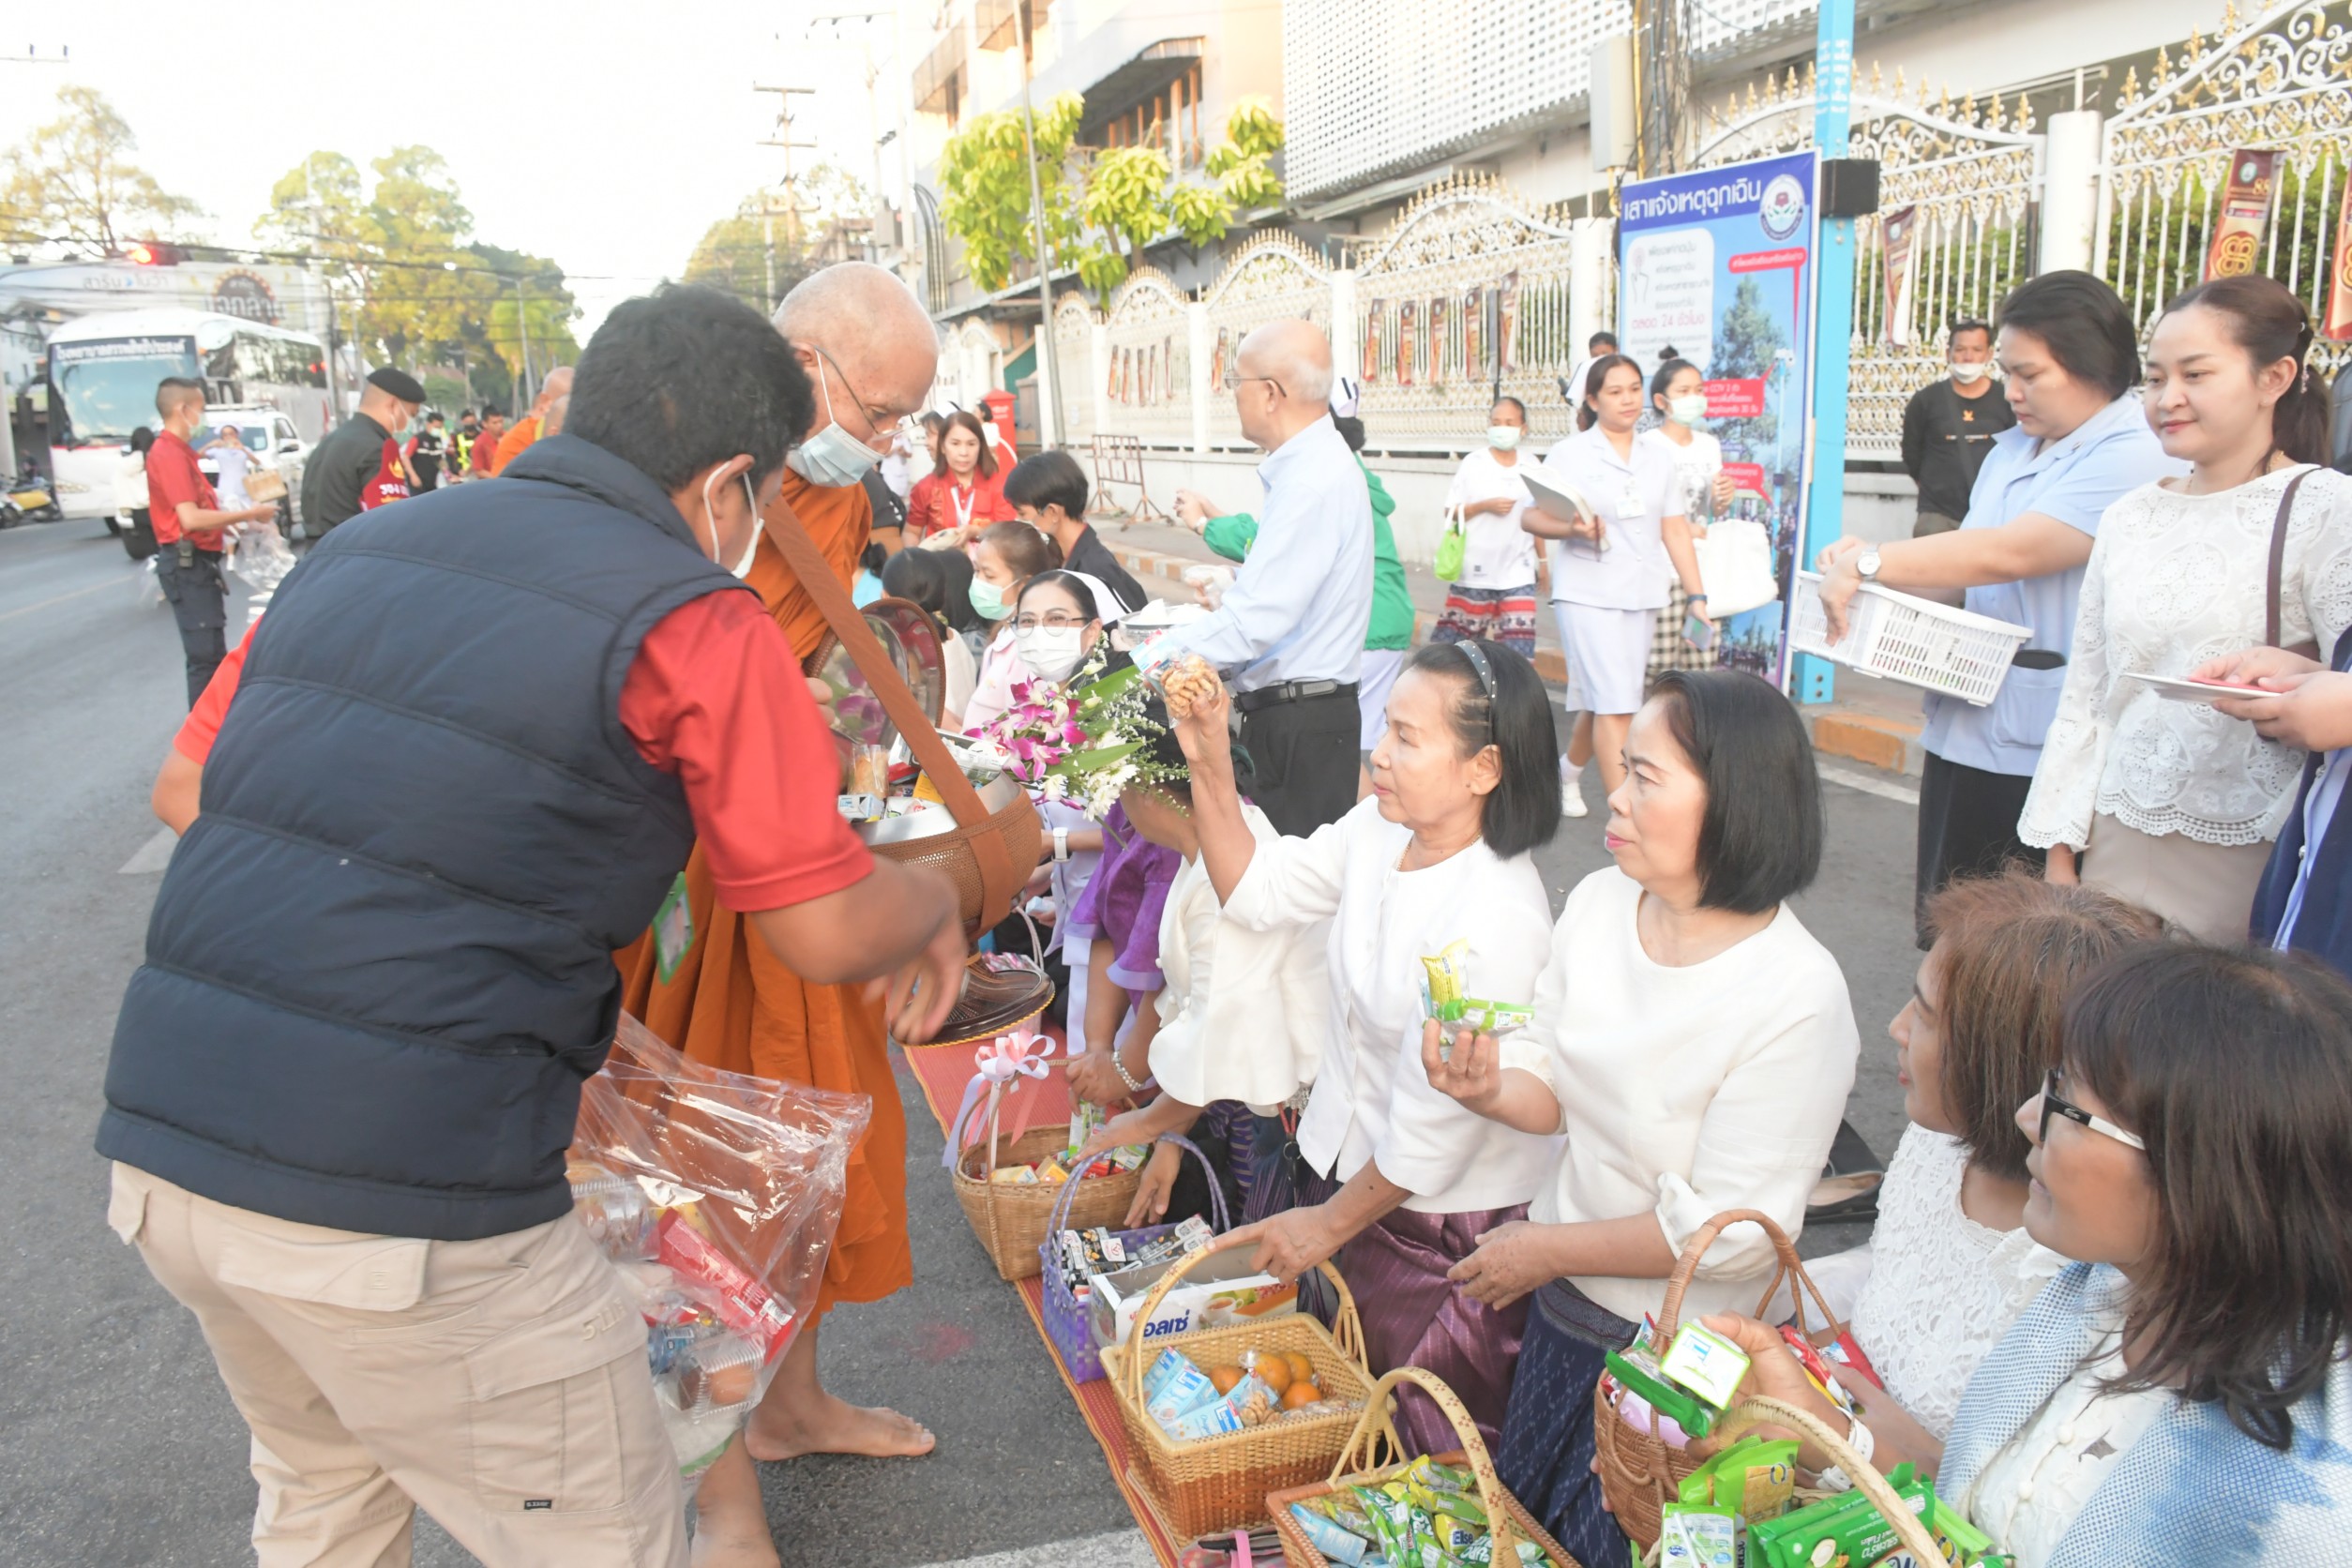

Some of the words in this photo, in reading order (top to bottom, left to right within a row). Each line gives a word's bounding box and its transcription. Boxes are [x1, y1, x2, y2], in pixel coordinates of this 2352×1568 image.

[1624, 178, 1761, 221] เสาแจ้งเหตุฉุกเฉิน
[1662, 314, 1674, 327] 24
[1143, 1308, 1191, 1337] อลเซ่
[1453, 1530, 1473, 1545] Else
